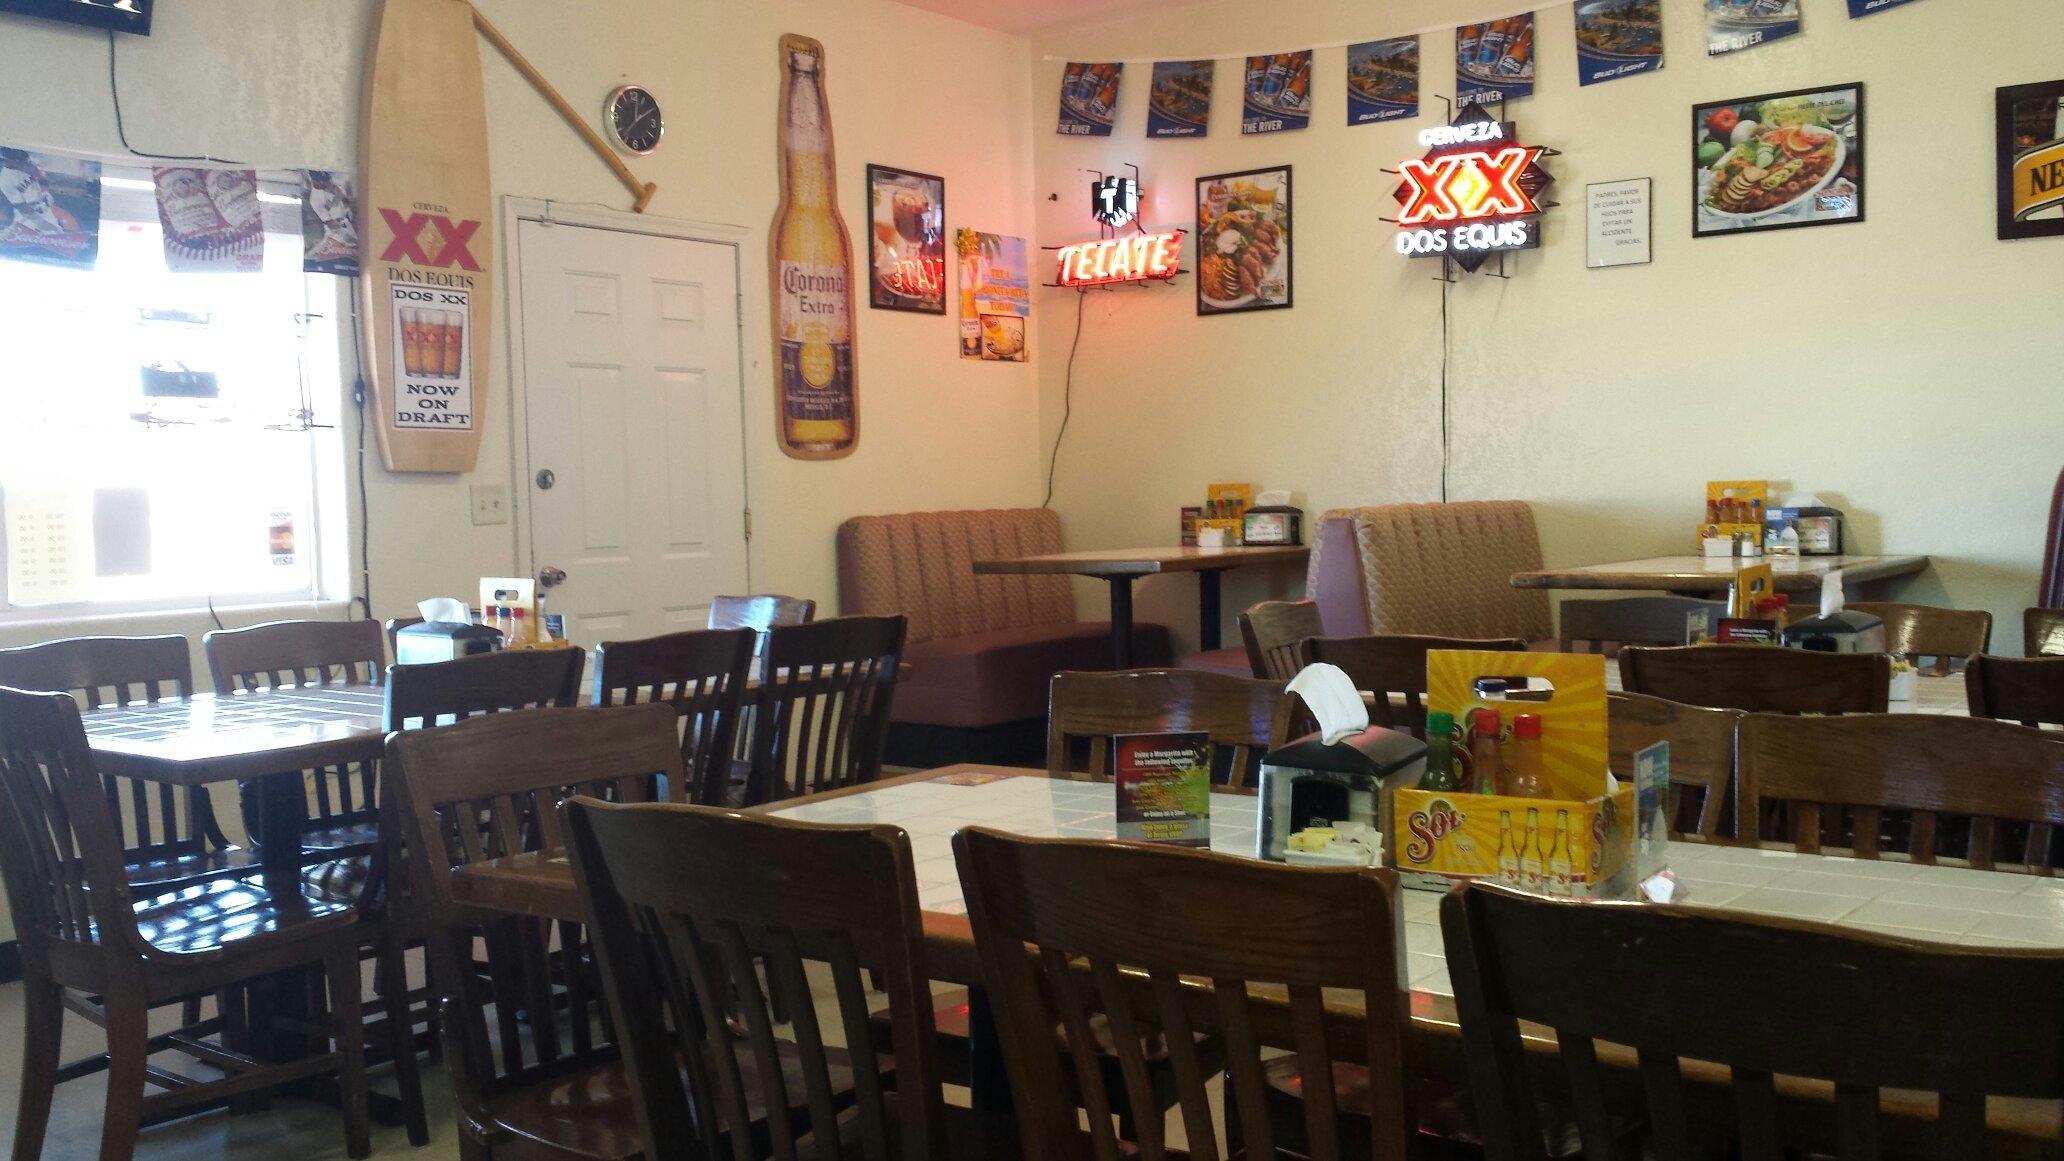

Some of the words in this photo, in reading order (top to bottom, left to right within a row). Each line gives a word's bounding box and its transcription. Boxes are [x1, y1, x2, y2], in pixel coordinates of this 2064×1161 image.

[1708, 40, 1729, 54] THE
[1731, 31, 1763, 49] RIVER
[1593, 70, 1615, 79] BUD
[1618, 62, 1648, 74] LIGHT
[1457, 95, 1473, 107] THE
[1475, 90, 1503, 104] RIVER
[650, 119, 657, 128] 3
[1358, 113, 1379, 121] BUD
[1380, 109, 1406, 118] LIGHT
[1058, 124, 1070, 134] THE
[1071, 124, 1091, 135] RIVER
[1243, 123, 1258, 134] THE
[1259, 120, 1283, 132] RIVER
[1418, 121, 1503, 147] CERVEZA
[632, 140, 639, 149] 6
[1399, 147, 1528, 226] XX
[412, 202, 448, 213] CERVEZA
[378, 206, 482, 272] XX
[1397, 228, 1448, 254] DOS
[1453, 220, 1527, 250] EQUIS
[1057, 234, 1174, 282] TECATE
[388, 267, 421, 284] DOS
[426, 271, 474, 289] EQUIS
[784, 266, 843, 295] Corona
[394, 289, 434, 302] DOS
[440, 294, 468, 306] XX
[800, 295, 835, 314] Extra
[406, 384, 460, 396] NOW
[418, 399, 450, 410] ON
[398, 412, 470, 424] DRAFT
